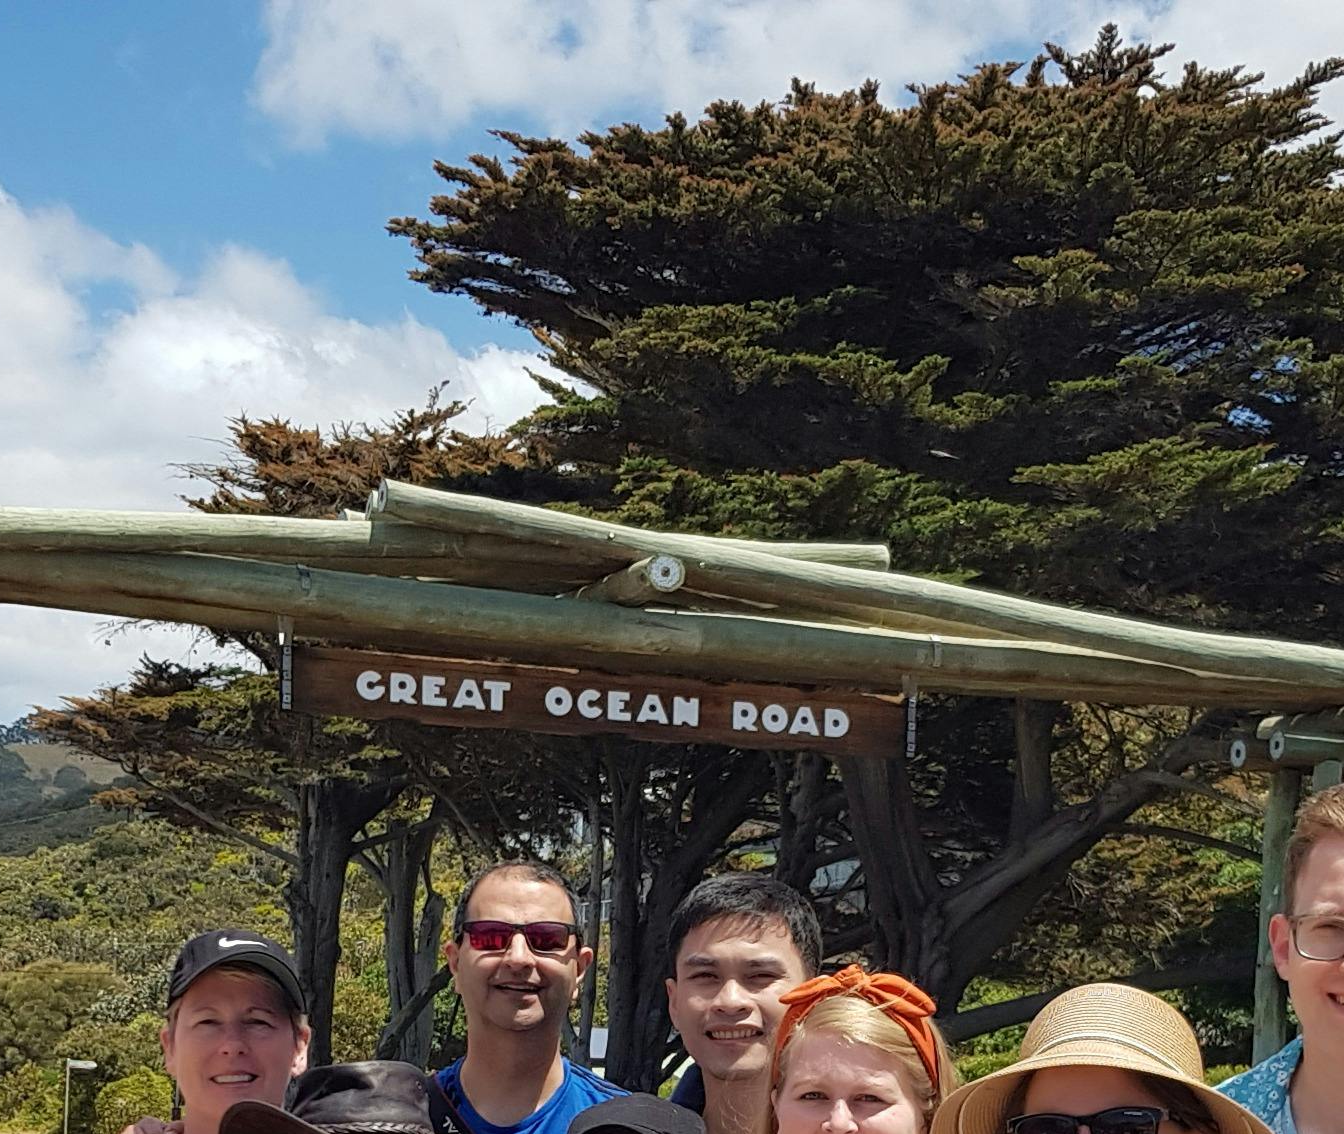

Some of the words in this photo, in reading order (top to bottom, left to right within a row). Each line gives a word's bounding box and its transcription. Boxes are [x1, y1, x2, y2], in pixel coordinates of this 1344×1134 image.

[355, 670, 511, 711] GREAT
[544, 686, 699, 727] OCEAN
[732, 701, 850, 738] ROAD
